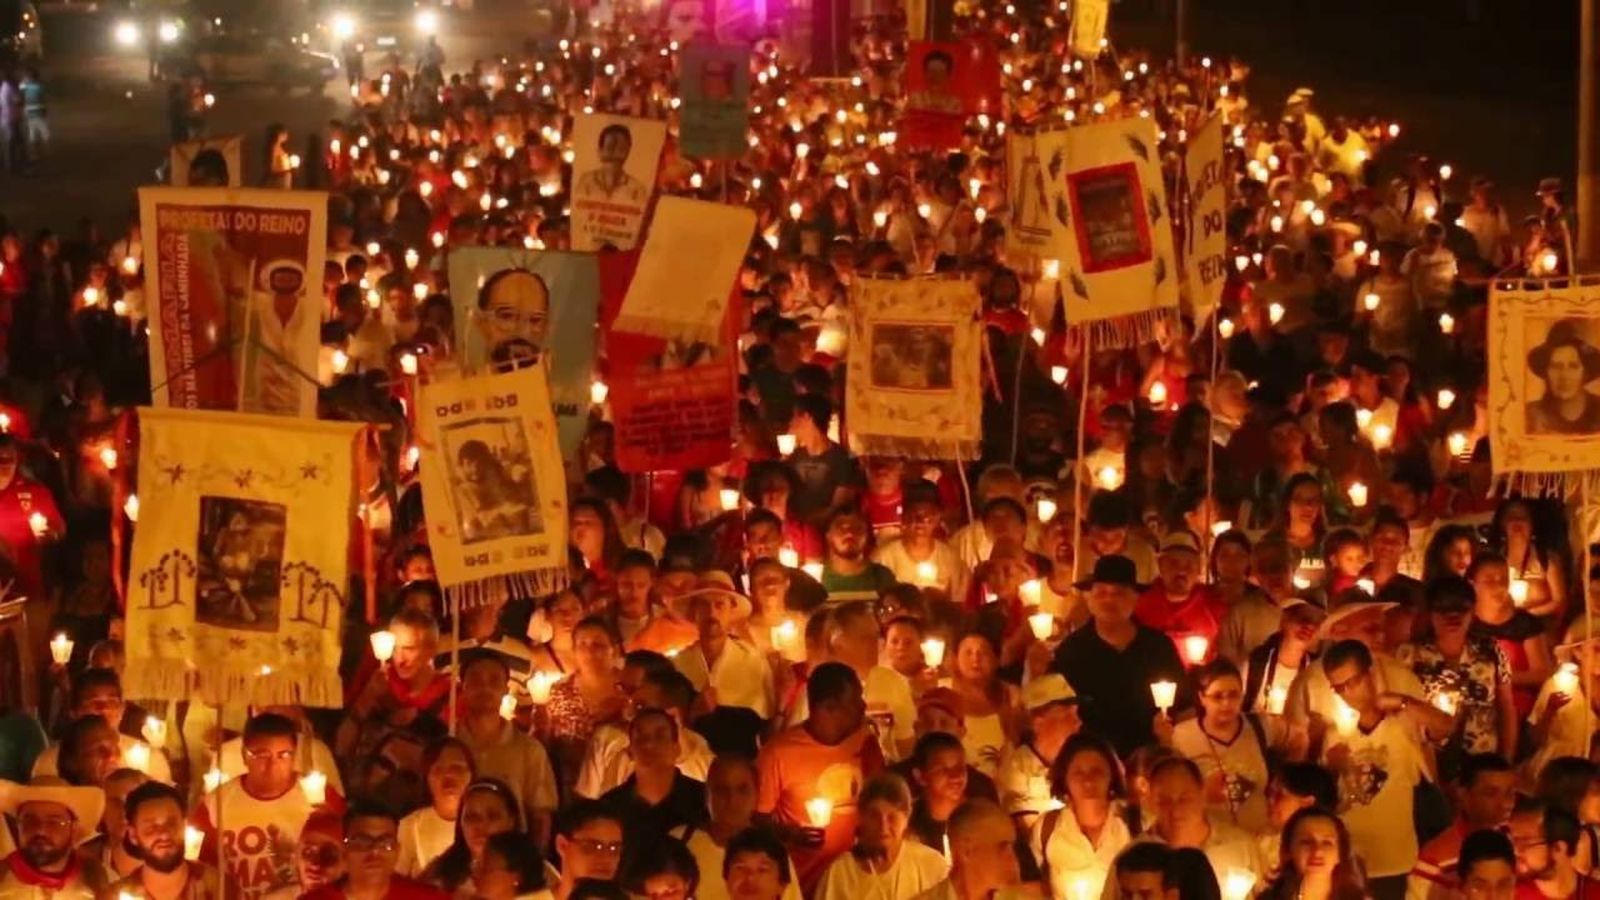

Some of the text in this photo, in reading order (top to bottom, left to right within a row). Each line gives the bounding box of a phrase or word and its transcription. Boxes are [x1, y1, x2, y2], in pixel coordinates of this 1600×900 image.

[159, 209, 307, 235] PROFETAS DO REINO
